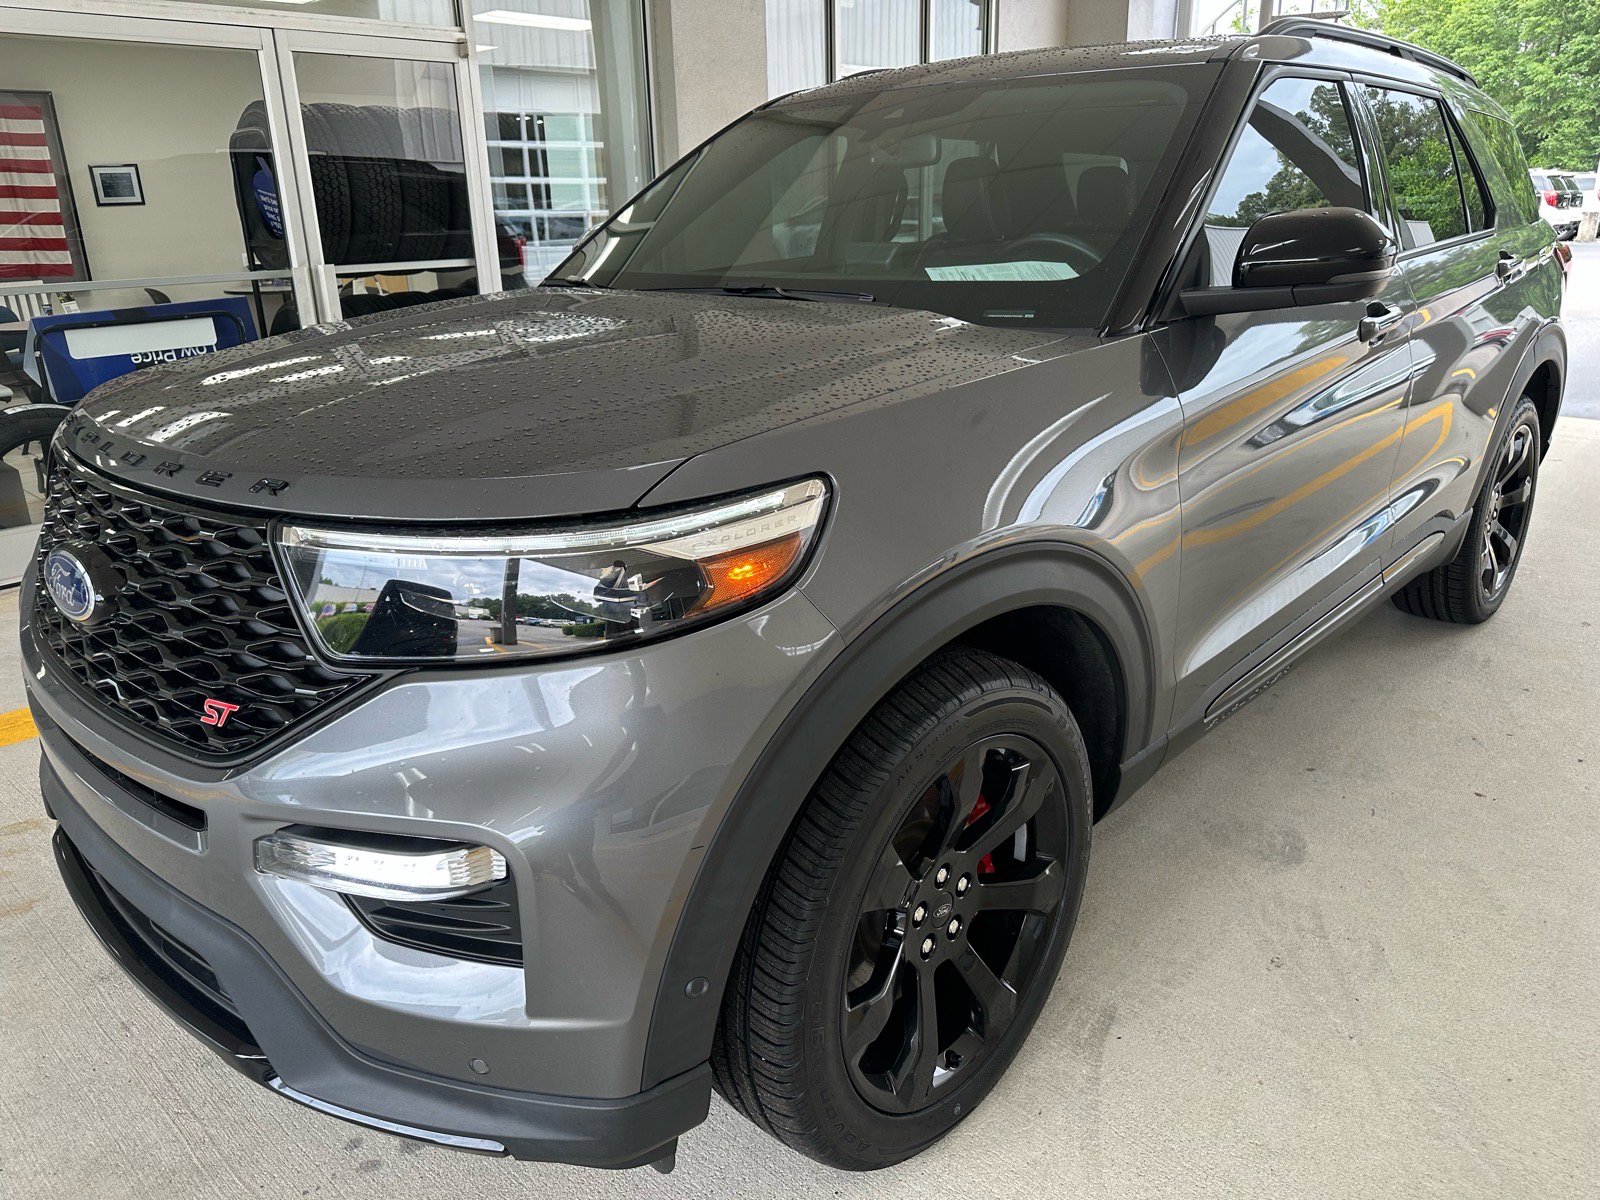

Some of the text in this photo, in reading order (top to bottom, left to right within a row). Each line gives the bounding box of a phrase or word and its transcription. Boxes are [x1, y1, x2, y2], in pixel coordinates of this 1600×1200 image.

[131, 349, 178, 365] Price
[67, 413, 290, 496] PLORER
[691, 514, 798, 551] EXPLORER
[200, 698, 240, 727] ST
